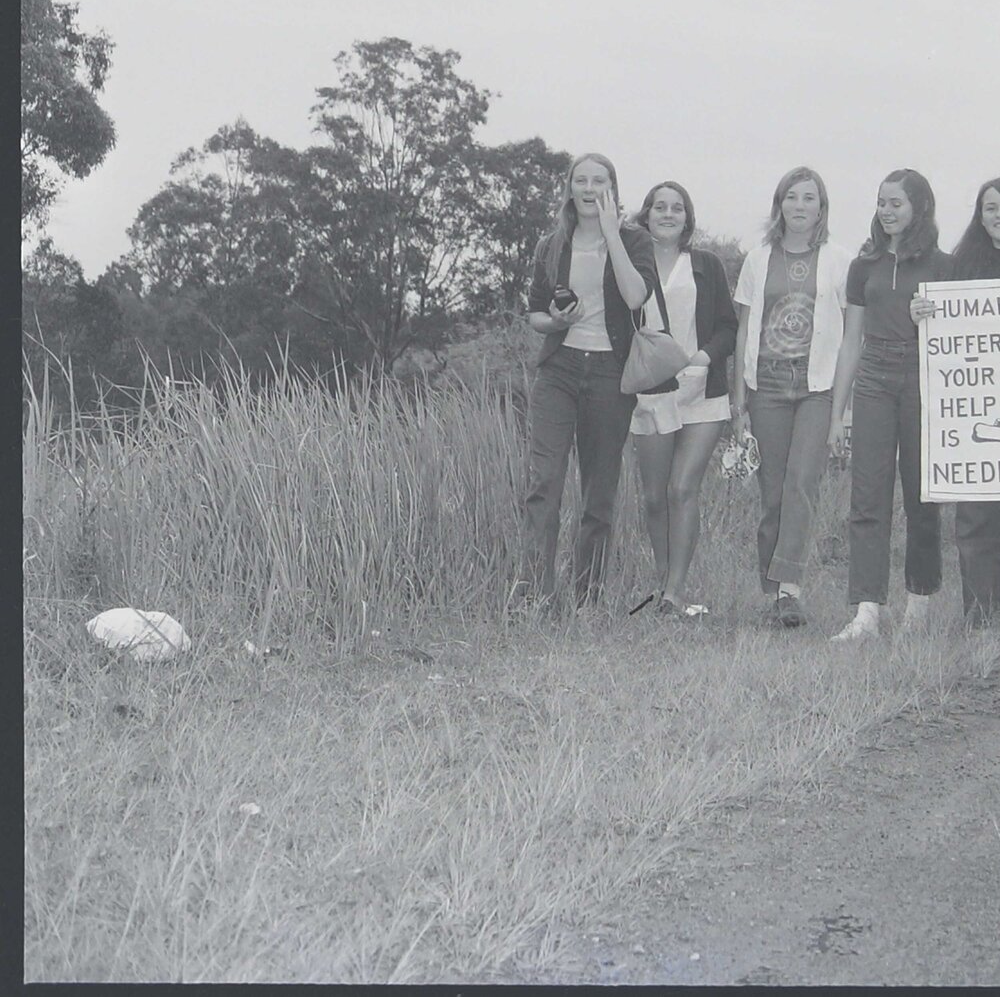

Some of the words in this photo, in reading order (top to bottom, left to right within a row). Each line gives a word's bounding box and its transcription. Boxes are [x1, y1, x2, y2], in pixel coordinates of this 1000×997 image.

[939, 367, 995, 388] YOUR
[940, 396, 996, 418] HELP
[941, 429, 960, 448] IS
